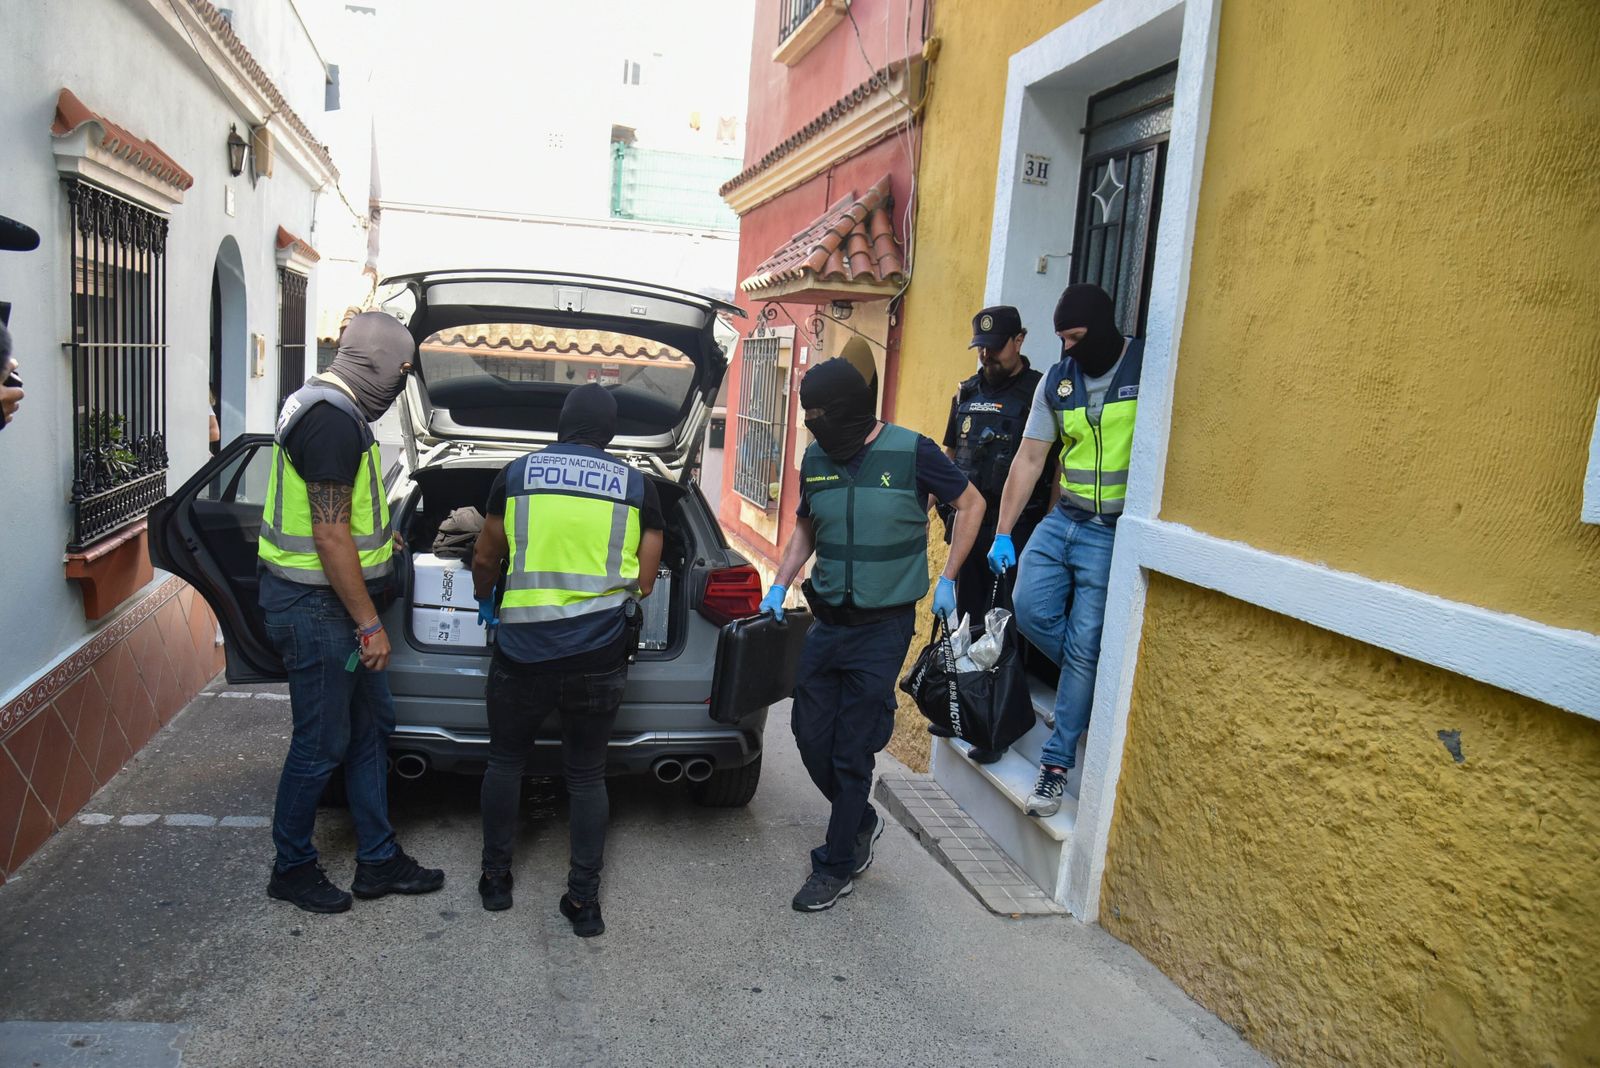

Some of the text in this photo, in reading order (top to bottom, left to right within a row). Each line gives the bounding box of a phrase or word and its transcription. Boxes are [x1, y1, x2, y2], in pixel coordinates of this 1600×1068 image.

[530, 455, 625, 476] CUERPO NACIONAL DE
[527, 466, 622, 494] POLICIA
[441, 570, 449, 602] OLICIA
